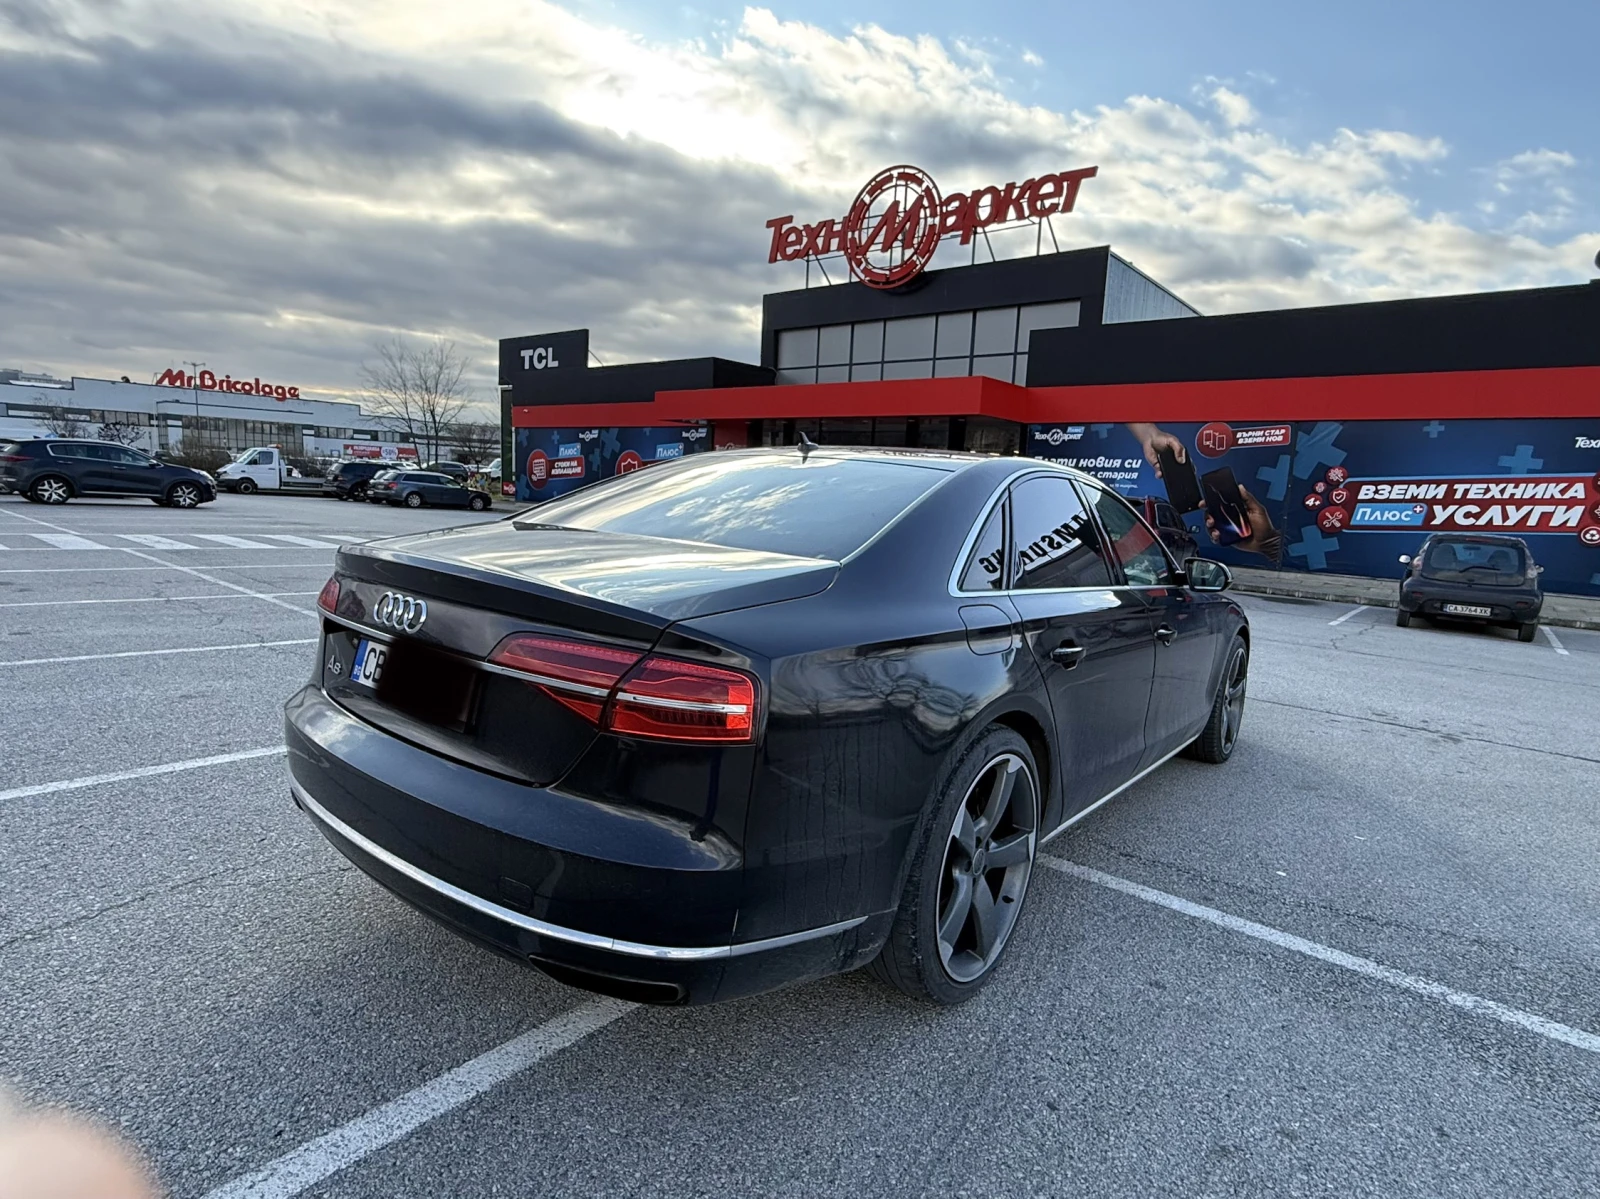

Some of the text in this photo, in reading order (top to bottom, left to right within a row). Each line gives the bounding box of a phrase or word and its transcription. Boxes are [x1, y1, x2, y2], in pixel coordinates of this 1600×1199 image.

[520, 347, 559, 370] TCL
[199, 369, 299, 402] Bricolage
[1236, 428, 1286, 439] ВЪРНИ СТАР
[1238, 435, 1284, 444] ВЗЕМИ НОВ
[1078, 455, 1121, 469] новия
[1124, 458, 1142, 469] си
[1097, 470, 1139, 480] стария
[1357, 482, 1586, 500] ВЗЕМИ ТЕХНИКА
[1430, 504, 1586, 528] УСЛУГИ
